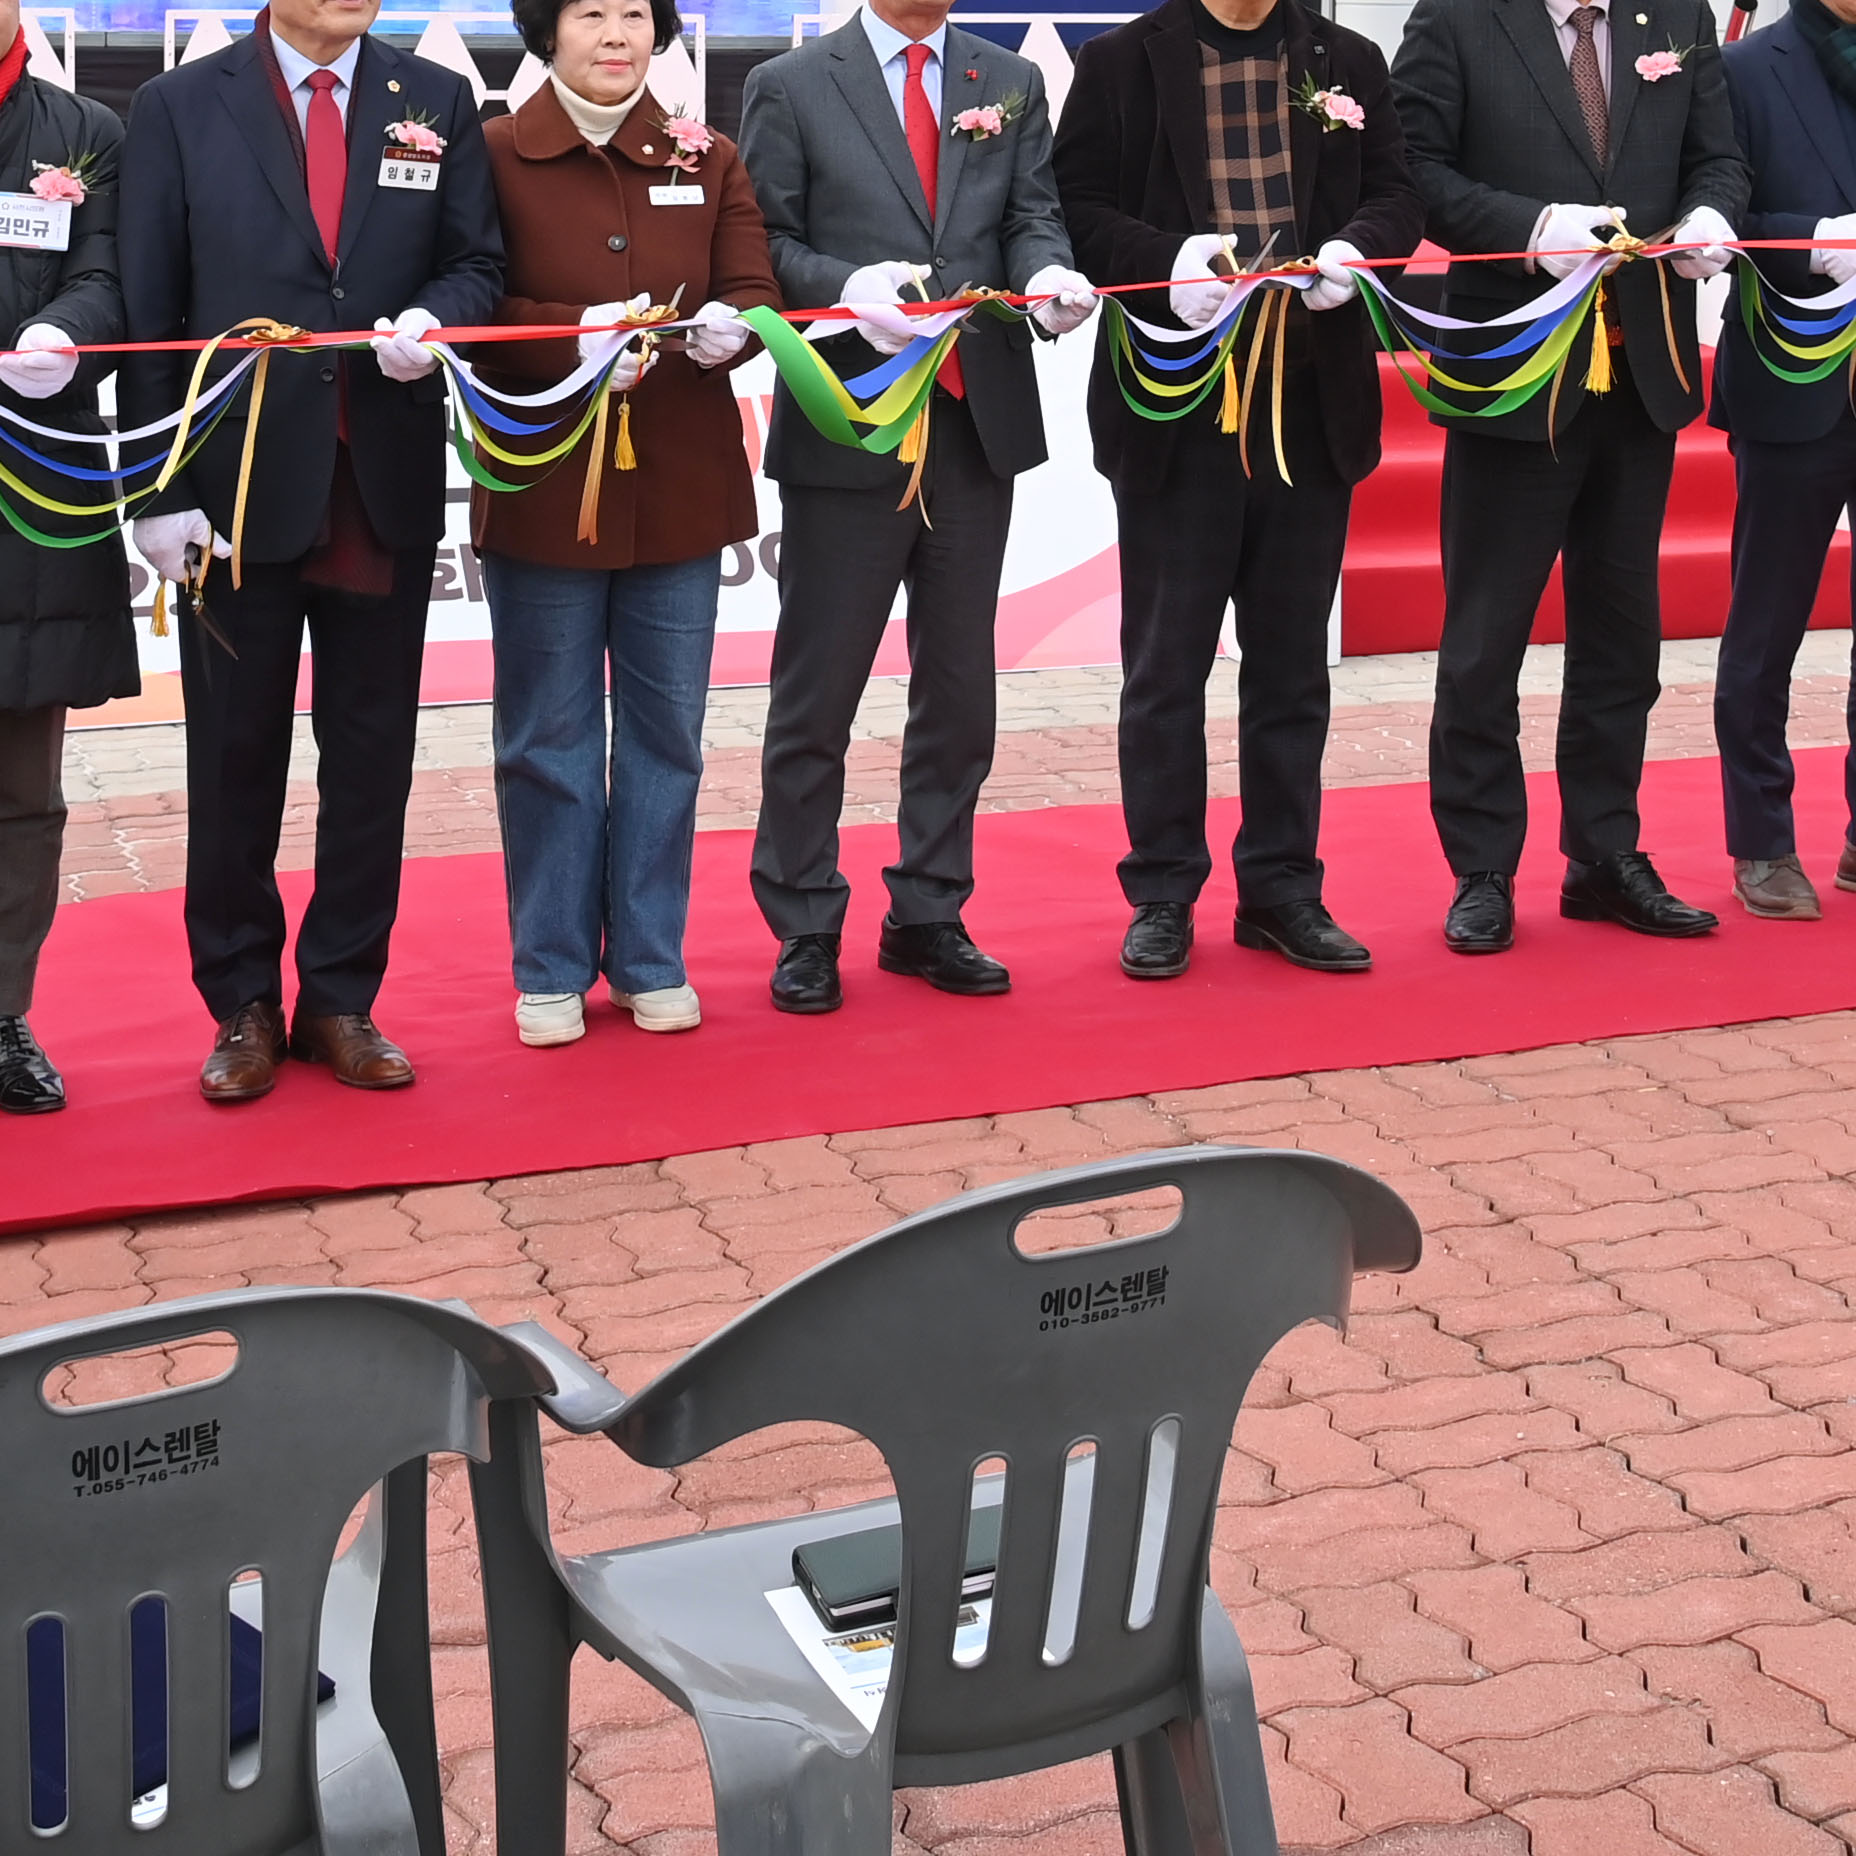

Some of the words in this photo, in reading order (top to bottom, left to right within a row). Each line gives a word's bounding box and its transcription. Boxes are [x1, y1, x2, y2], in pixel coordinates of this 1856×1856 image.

[387, 166, 432, 183] 임철규
[1039, 1264, 1170, 1317] 에이스렌탈
[1039, 1295, 1166, 1332] 010-3582-9771
[71, 1418, 221, 1482] 에이스렌탈
[73, 1455, 220, 1498] T.055-746-4774
